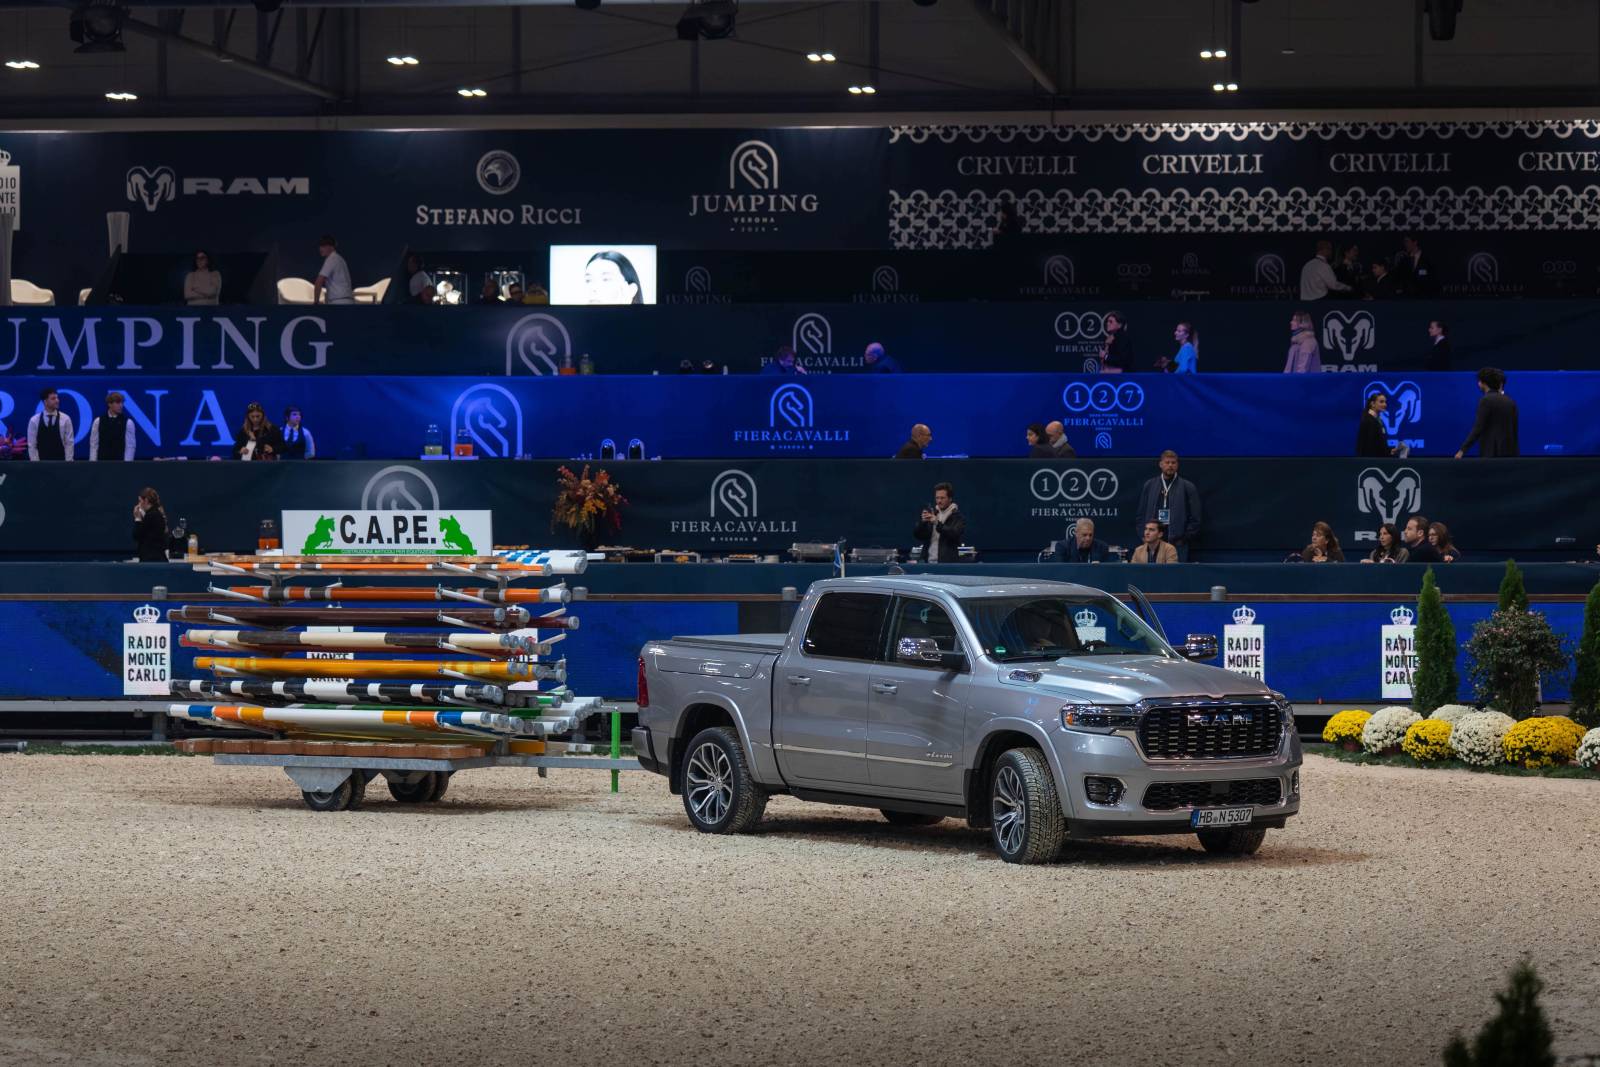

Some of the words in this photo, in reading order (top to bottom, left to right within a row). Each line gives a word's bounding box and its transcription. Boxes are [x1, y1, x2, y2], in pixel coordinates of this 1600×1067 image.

[956, 155, 1079, 176] CRIVELLI
[1141, 153, 1264, 175] CRIVELLI
[1329, 152, 1451, 173] CRIVELLI
[183, 177, 310, 195] RAM
[688, 193, 820, 216] JUMPING
[415, 204, 515, 226] STEFANO
[520, 204, 582, 225] RICCI
[1320, 363, 1379, 373] RAM
[734, 430, 850, 441] FIERACAVALLI
[1031, 507, 1119, 517] FIERACAVALLI
[339, 514, 437, 545] C.A.P.E.
[670, 520, 798, 533] FIERACAVALLI
[127, 635, 167, 649] RADIO
[1227, 637, 1261, 651] RADIO
[127, 652, 167, 666] MONTE
[1227, 654, 1261, 668] MONTE
[127, 668, 167, 682] CARLO
[1199, 811, 1213, 824] HB
